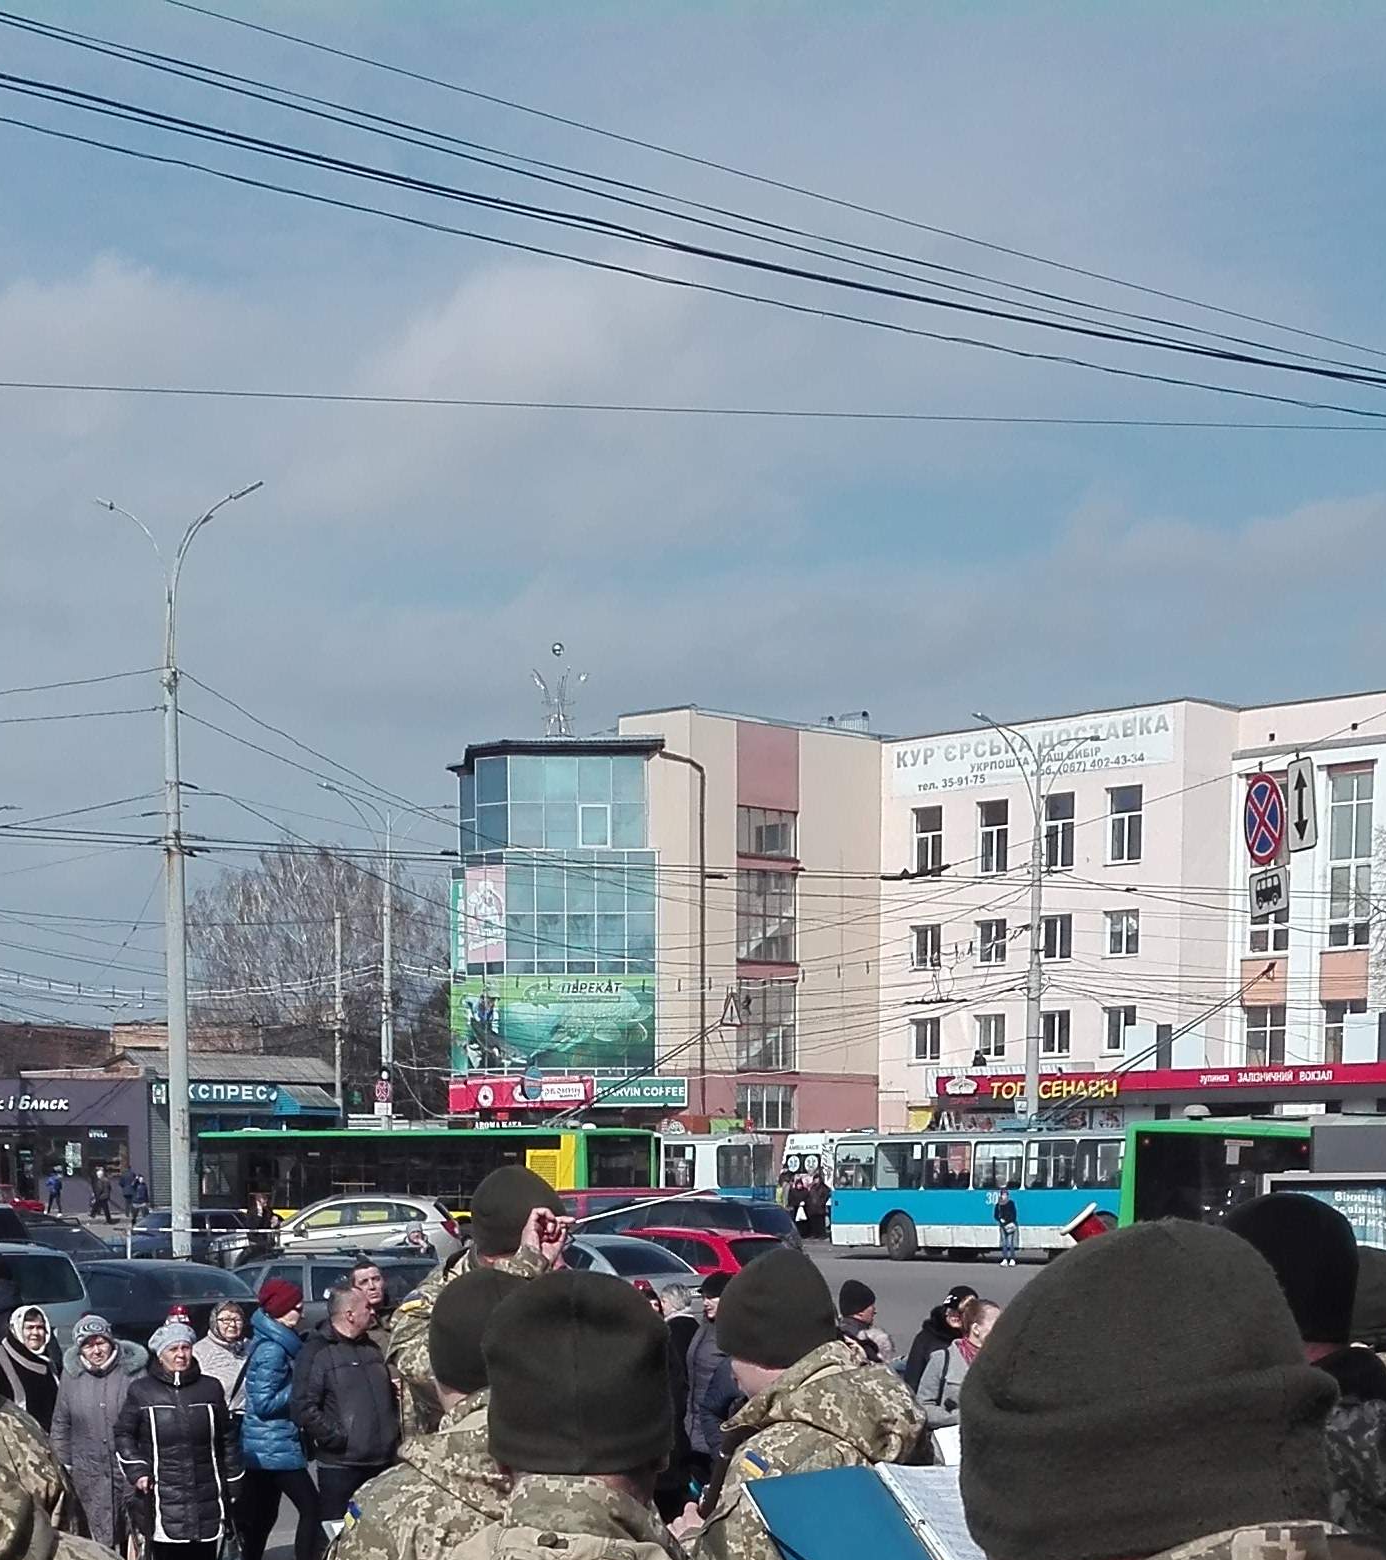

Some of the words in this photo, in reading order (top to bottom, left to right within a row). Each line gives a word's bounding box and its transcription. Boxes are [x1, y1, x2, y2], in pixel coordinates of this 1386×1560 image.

[1089, 752, 1145, 769] 402-43-34
[917, 782, 939, 792] тел.
[941, 773, 986, 789] 35-91-75
[188, 1083, 268, 1100] КСПРЕС
[642, 1086, 686, 1097] COFFEE
[7, 1095, 14, 1110] і
[18, 1094, 70, 1111] Блиск
